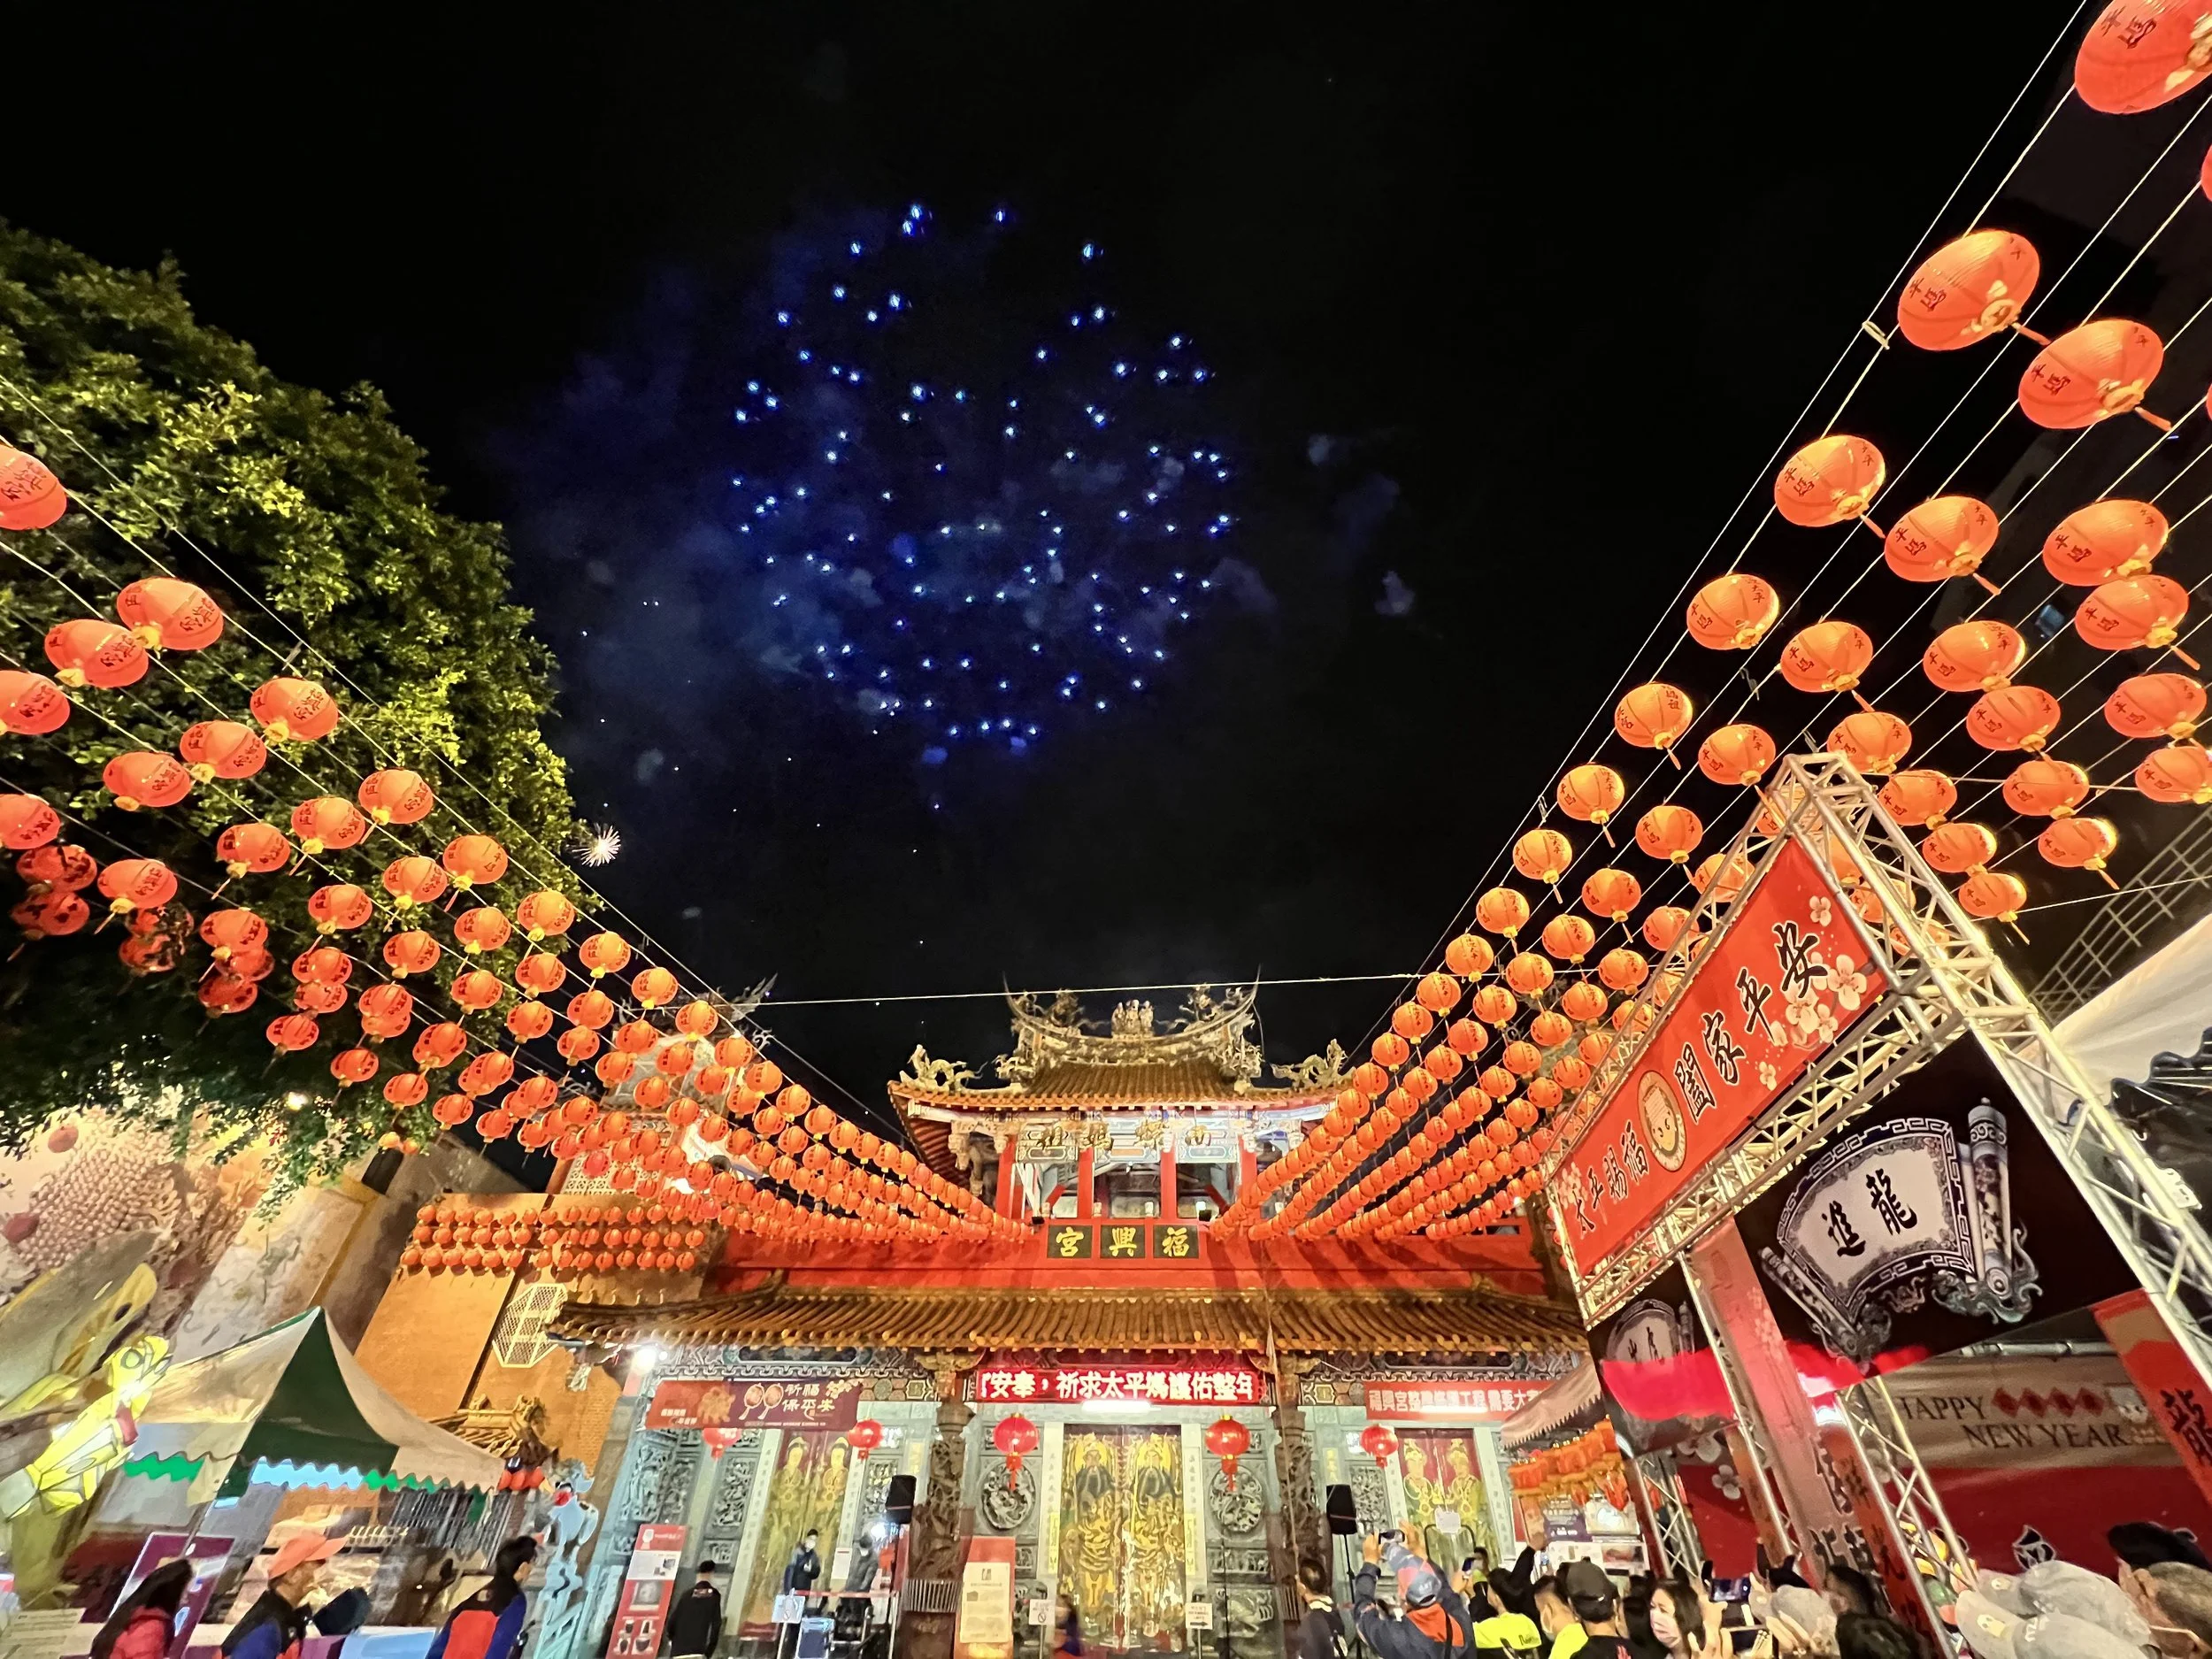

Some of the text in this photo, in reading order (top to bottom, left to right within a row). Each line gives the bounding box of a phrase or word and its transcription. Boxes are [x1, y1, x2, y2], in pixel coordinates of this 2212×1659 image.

[1571, 922, 1829, 1238] 太平賜福 闔家平安
[1960, 1423, 2130, 1449] NEW YEAR
